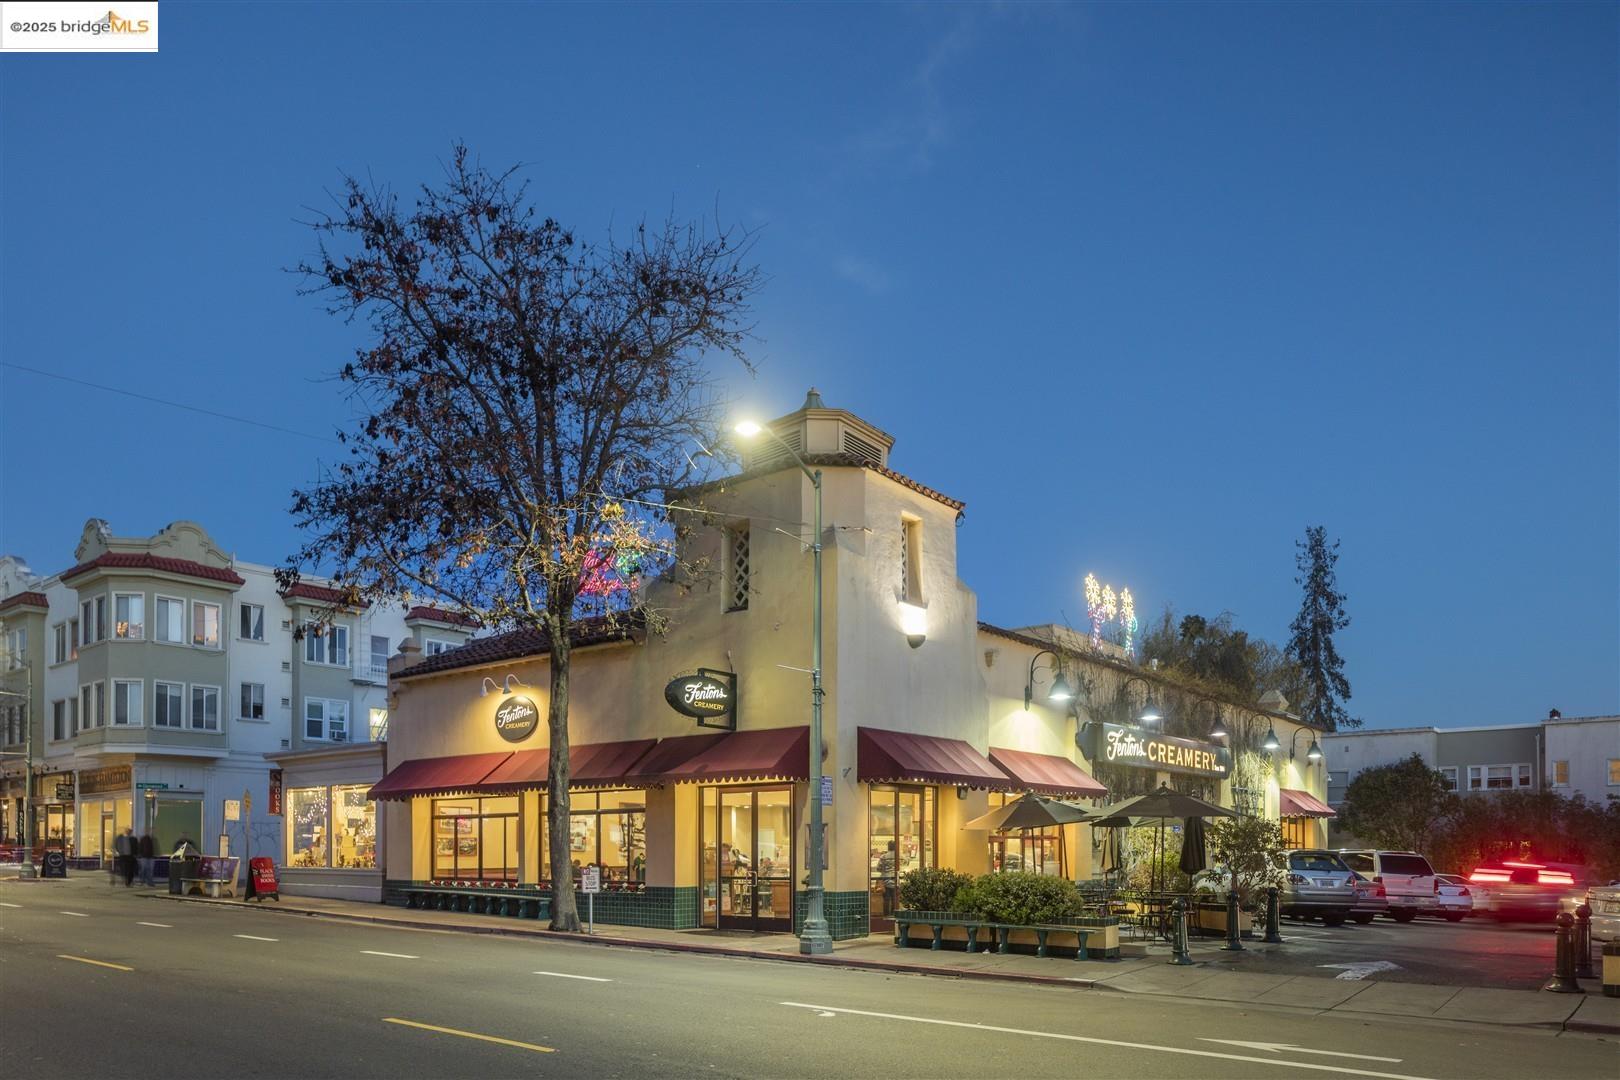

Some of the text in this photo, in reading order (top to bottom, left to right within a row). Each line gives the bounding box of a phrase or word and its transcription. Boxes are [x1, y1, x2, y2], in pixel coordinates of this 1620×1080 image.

[684, 682, 728, 704] Fentons
[497, 704, 534, 728] Fentons
[693, 700, 725, 711] CREAMERY
[505, 721, 531, 730] CREAMERY
[1147, 740, 1217, 771] CREAMERY
